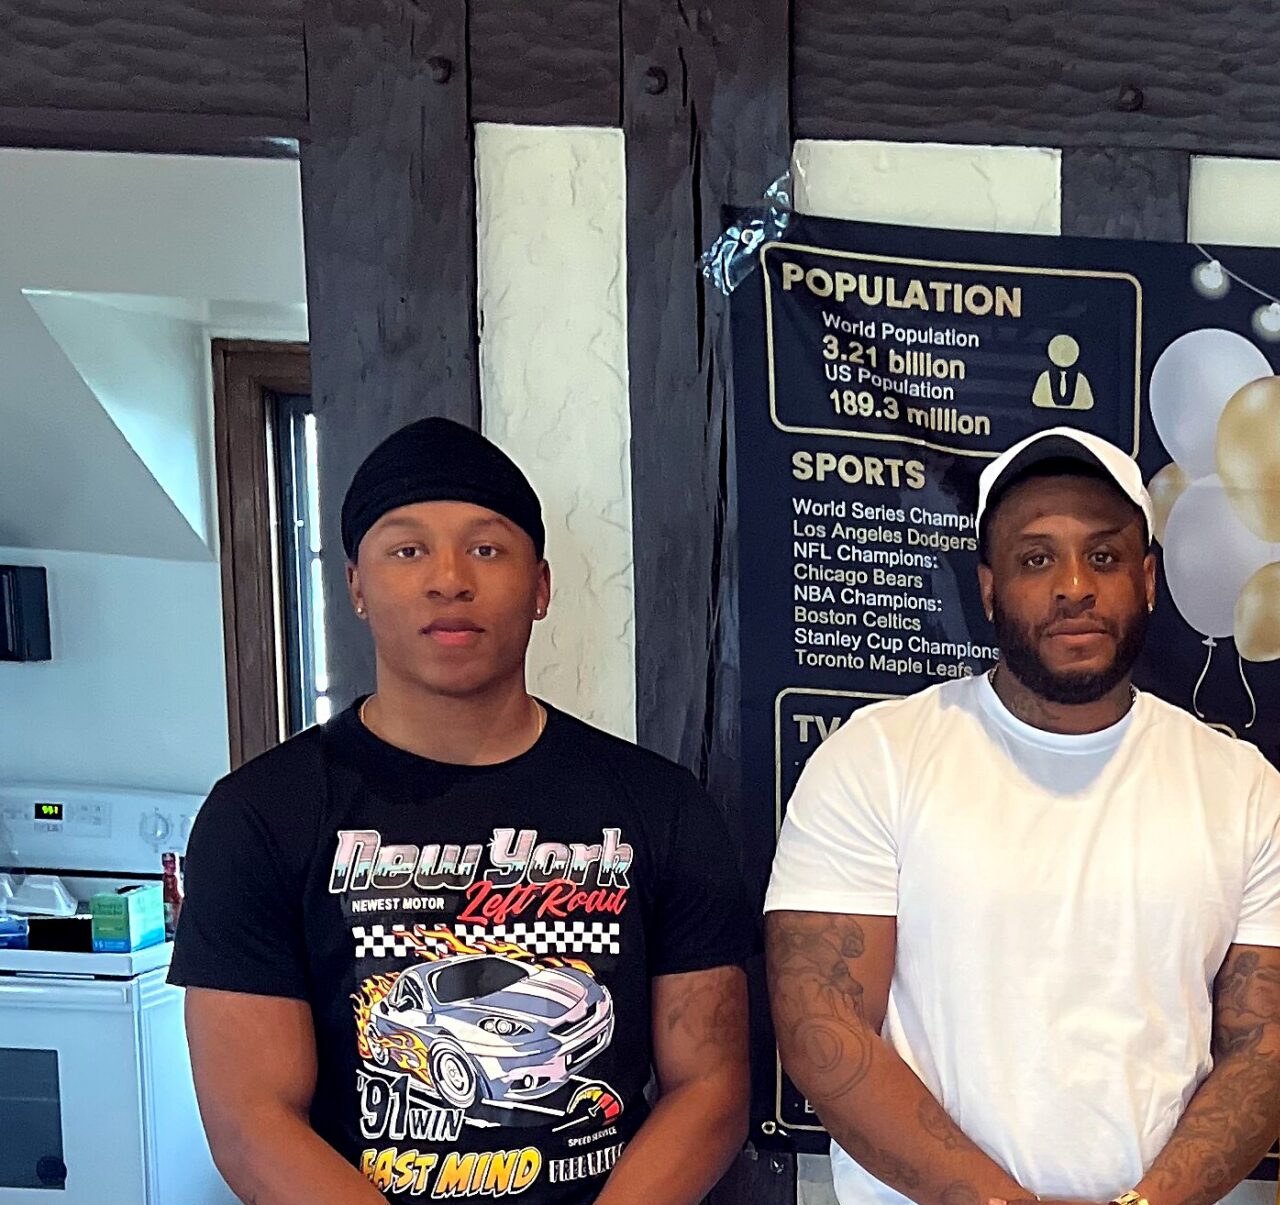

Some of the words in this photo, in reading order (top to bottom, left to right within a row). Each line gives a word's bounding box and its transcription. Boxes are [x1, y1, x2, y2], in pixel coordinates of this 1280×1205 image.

[782, 262, 1022, 318] POPULATION
[822, 310, 876, 340] World
[881, 324, 980, 349] Population
[822, 335, 878, 367] 3.21
[888, 349, 966, 381] billion
[824, 363, 852, 384] US
[858, 369, 954, 402] Population
[829, 388, 900, 421] 189.3
[907, 406, 991, 436] million
[792, 451, 926, 489] SPORTS
[792, 498, 846, 518] World
[851, 502, 905, 523] Series
[910, 507, 977, 531] Champi
[793, 520, 826, 538] Los
[831, 523, 902, 545] Angeles
[908, 528, 977, 552] Dodgers
[793, 541, 832, 560] NFL
[837, 545, 939, 569] Champions:
[793, 563, 868, 585] Chicago
[873, 568, 923, 588] Bears
[794, 584, 836, 604] NBA
[840, 588, 943, 612] Champions:
[794, 607, 857, 627] Boston
[862, 611, 922, 631] Celtics
[794, 628, 862, 650] Stanley
[866, 633, 903, 654] Cup
[795, 649, 864, 670] Toronto
[869, 654, 923, 675] Maple
[328, 829, 483, 893] New
[484, 827, 634, 889] York
[352, 898, 400, 913] NEWEST
[402, 897, 444, 910] MOTOR
[456, 879, 538, 926] Left
[537, 877, 627, 919] Road
[408, 1108, 466, 1142] WIN
[431, 1146, 543, 1199] MIND
